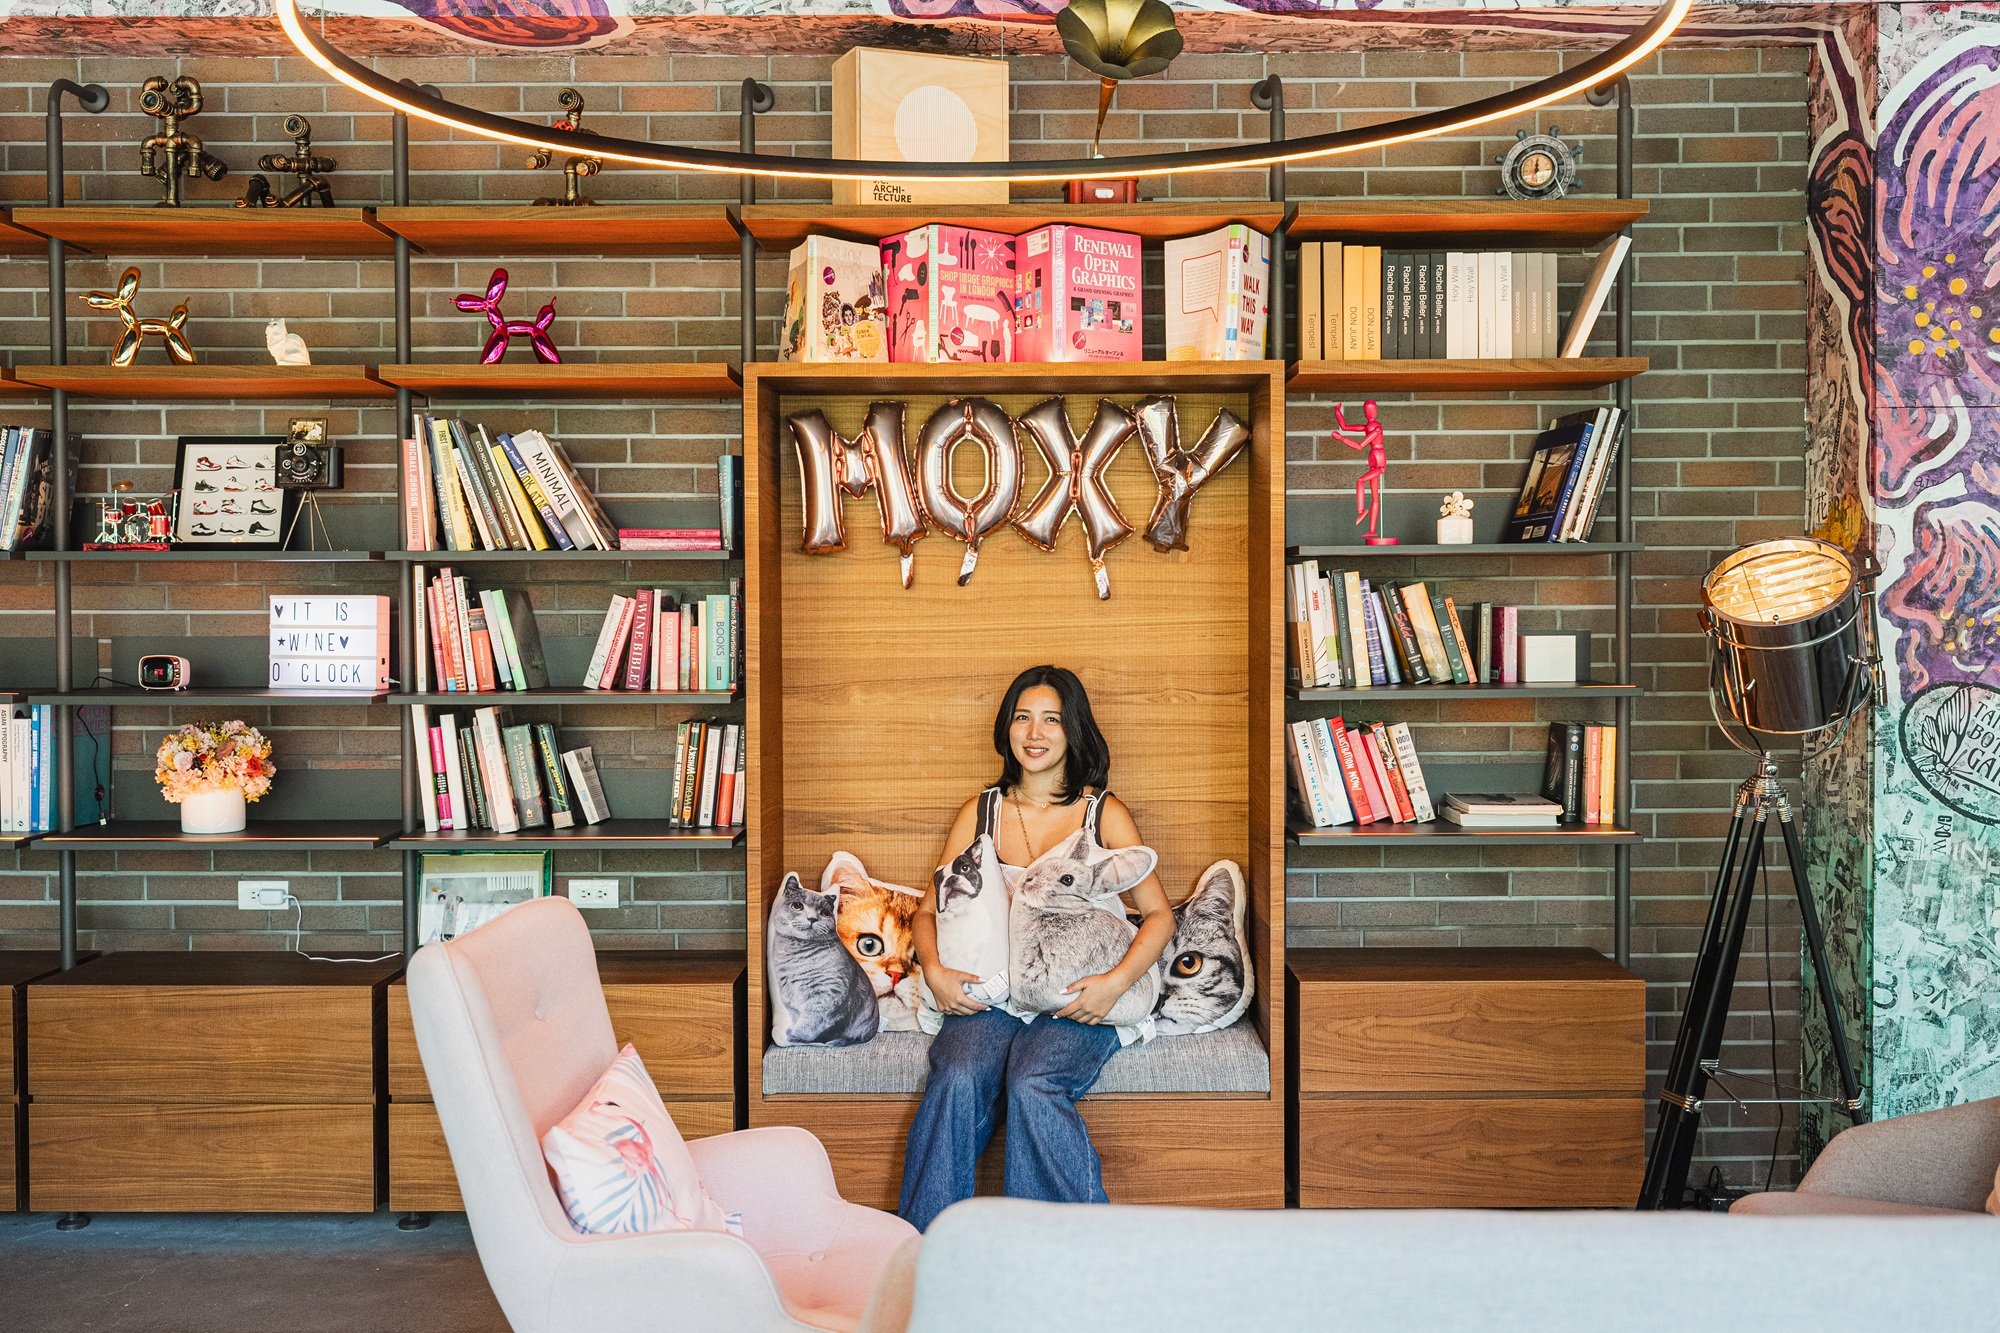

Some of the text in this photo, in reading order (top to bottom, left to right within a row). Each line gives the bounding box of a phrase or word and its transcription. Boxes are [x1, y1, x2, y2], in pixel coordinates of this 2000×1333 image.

[873, 193, 911, 203] TECTURE
[874, 185, 904, 194] ARCHI-
[1074, 235, 1134, 258] RENEWAL
[1084, 254, 1119, 273] OPEN
[940, 270, 1014, 289] SHOP IMAGE GRAPHICS
[960, 284, 995, 297] IN LONDON
[1072, 267, 1136, 290] GRAPHICS
[1244, 274, 1259, 295] WALK
[1387, 265, 1395, 293] Rachel
[1243, 295, 1256, 314] THIS
[1452, 283, 1461, 302] Holy
[1467, 284, 1475, 302] Holy
[1501, 283, 1509, 302] Holy
[1386, 295, 1394, 319] Beller,
[1402, 295, 1410, 320] Beller,
[1435, 294, 1443, 319] Beller,
[1241, 317, 1254, 335] WAY
[438, 429, 447, 444] FIRST
[1608, 442, 1619, 463] muse
[456, 458, 464, 470] The
[460, 470, 468, 482] Art
[467, 490, 477, 509] Cutting
[531, 450, 572, 512] MINIMAL
[785, 394, 1251, 553] MOXY
[407, 442, 419, 539] MICHAEL JOHNSON BRANDING
[475, 440, 515, 536] ECO HOUSE BOOK TERENCE CONRAN
[501, 440, 511, 452] New
[509, 450, 522, 464] Poster
[530, 491, 544, 505] AT
[548, 518, 561, 534] Design
[437, 474, 452, 529] SOCIAL SPACES
[434, 580, 444, 611] MODERN
[1336, 576, 1344, 598] HOUSES
[294, 602, 348, 621] IT IS
[716, 621, 724, 656] BOOKS
[1393, 610, 1413, 640] Sold
[1405, 637, 1415, 654] AMERICA
[1447, 602, 1467, 654] PLAY ON
[289, 633, 335, 652] WINE
[629, 602, 648, 682] WINE BIBLE
[273, 663, 361, 682] O'CLOCK
[605, 647, 616, 674] RELAXATION
[0, 727, 8, 762] TYPOGRAPHY
[1311, 721, 1332, 758] Life Style
[1396, 735, 1410, 744] 1000
[517, 744, 531, 799] HARRY POTTER
[540, 739, 565, 796] Queer Street
[1335, 728, 1362, 791] ILLUSTRATION NOW!
[684, 745, 698, 806] WORLD WHISKY
[1299, 732, 1325, 813] THE WAY WE LIVE
[1934, 814, 1952, 855] GROW
